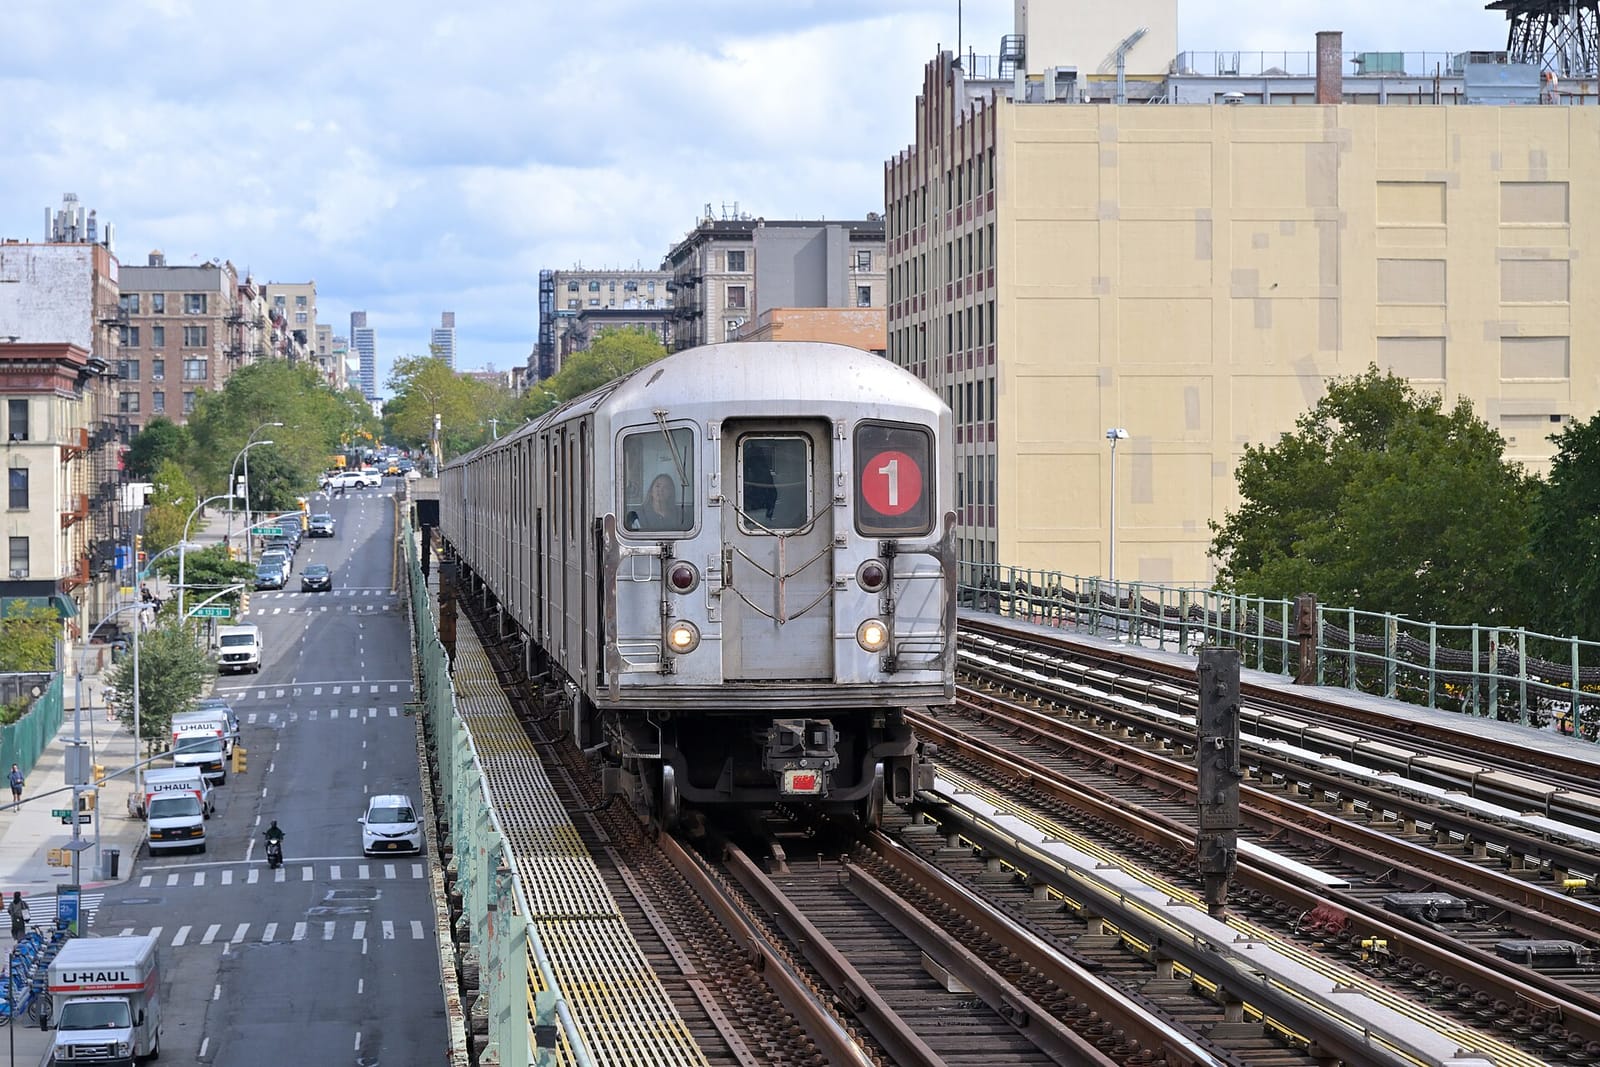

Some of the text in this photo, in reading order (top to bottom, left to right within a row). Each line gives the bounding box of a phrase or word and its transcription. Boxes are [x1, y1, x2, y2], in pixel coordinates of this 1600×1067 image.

[878, 459, 898, 506] 1
[153, 783, 192, 792] U-HAUL
[63, 971, 130, 983] U-HAUL
